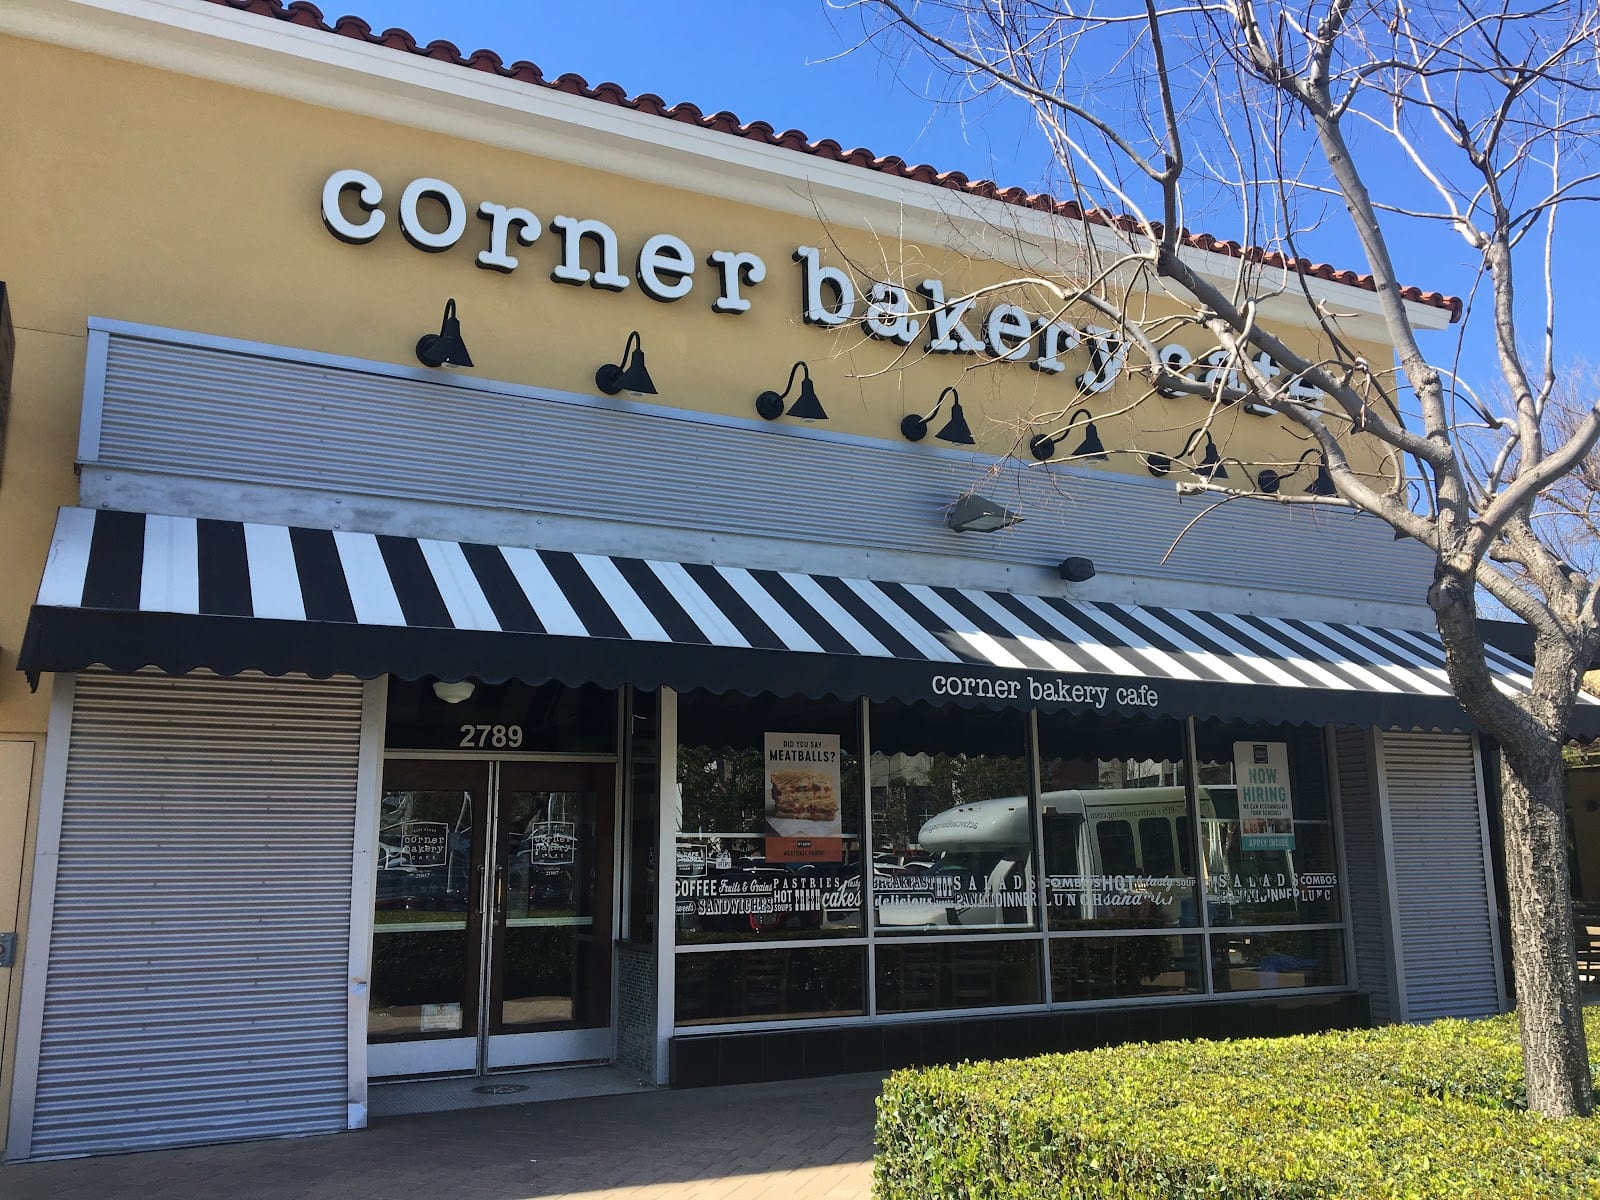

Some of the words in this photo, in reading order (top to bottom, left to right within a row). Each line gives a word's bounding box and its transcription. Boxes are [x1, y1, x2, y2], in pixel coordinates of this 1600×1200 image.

[321, 169, 767, 315] corner
[792, 244, 1130, 396] bakery
[932, 675, 1021, 699] corner
[1027, 677, 1110, 708] bakery
[1116, 684, 1159, 707] cafe
[459, 724, 523, 748] 2789
[783, 740, 794, 748] DID
[811, 741, 822, 749] SAY
[769, 749, 836, 763] MEATBALLS?
[1248, 767, 1277, 785] NOW
[1243, 786, 1286, 803] HIRING
[404, 836, 445, 844] corner
[1249, 838, 1267, 848] APPLY
[675, 879, 717, 897] COFFEE
[742, 881, 749, 893] &
[773, 876, 841, 889] PASTRIES
[936, 876, 954, 897] HOT
[953, 875, 1036, 891] SALADS
[1102, 874, 1136, 892] HOT
[1176, 878, 1197, 888] SOUP
[1300, 875, 1338, 885] COMBOS
[773, 889, 793, 904] HOT
[822, 879, 863, 908] cakes
[996, 891, 1038, 907] DINNER
[698, 896, 774, 916] SANDWICHES
[773, 903, 793, 912] SOUPS
